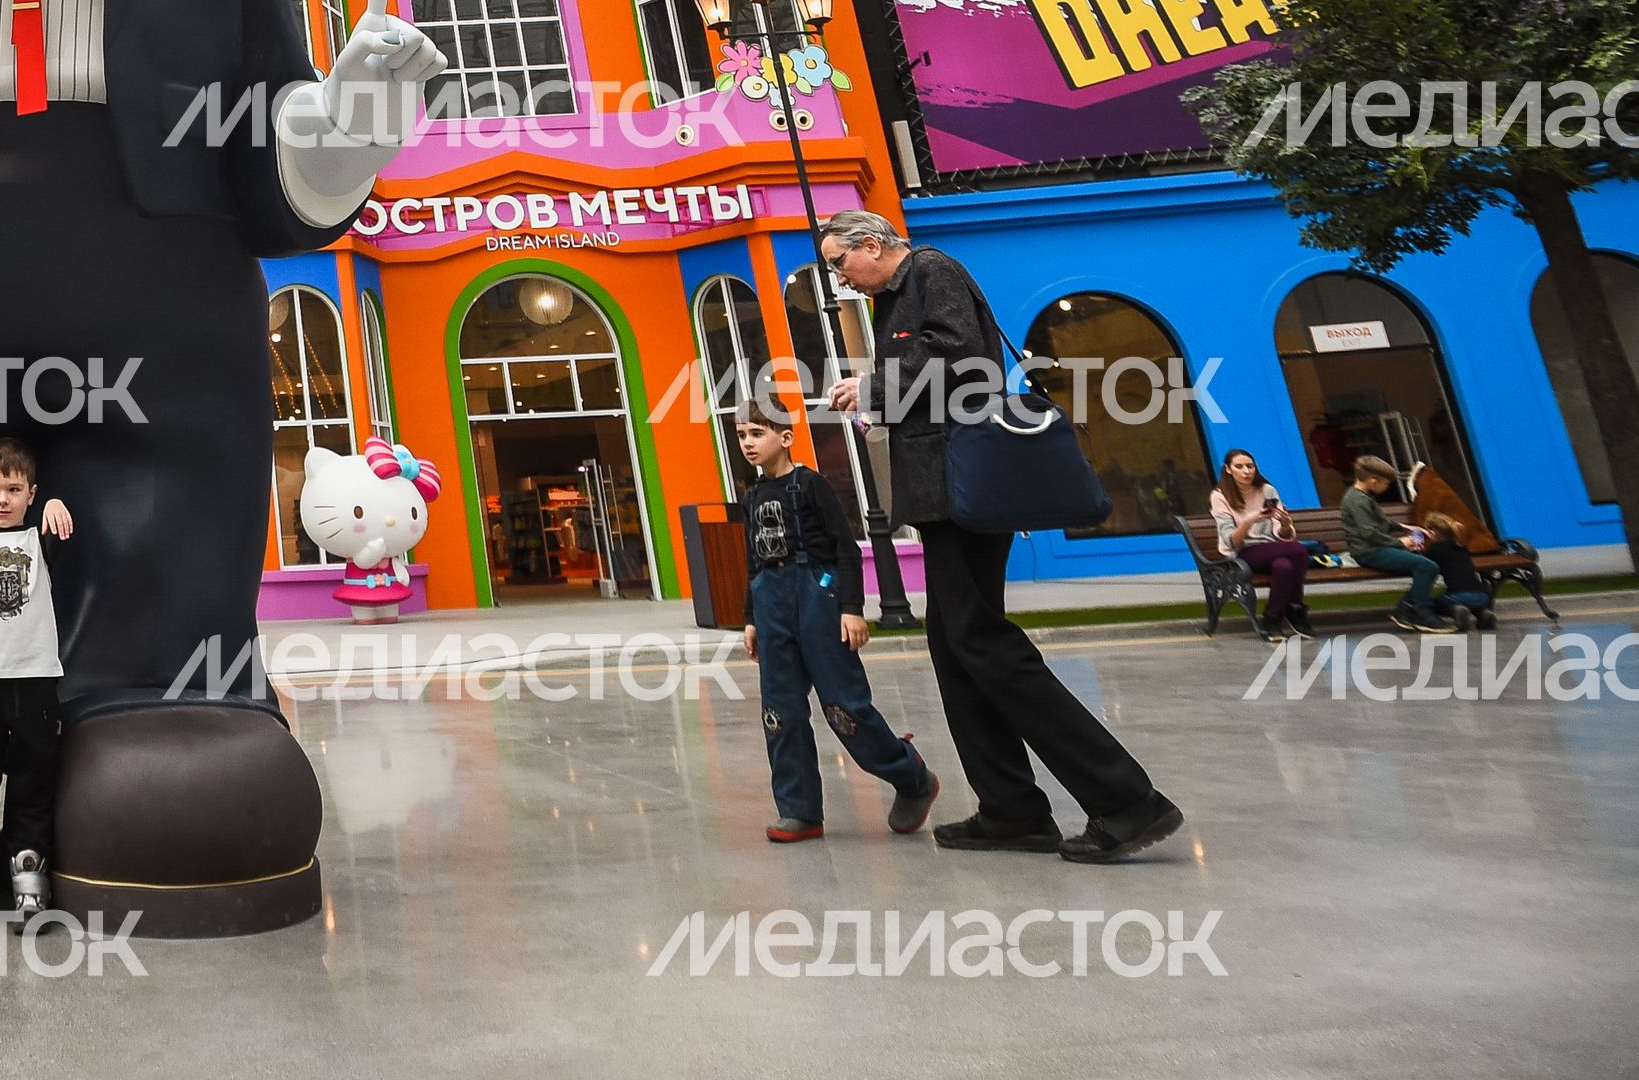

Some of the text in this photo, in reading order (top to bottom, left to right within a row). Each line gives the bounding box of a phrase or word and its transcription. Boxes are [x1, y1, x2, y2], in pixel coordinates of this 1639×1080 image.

[352, 184, 753, 236] ОСТРОВ МЕЧТЫ
[486, 232, 620, 252] DREAM ISLAND
[1326, 327, 1372, 339] ВЫХОД
